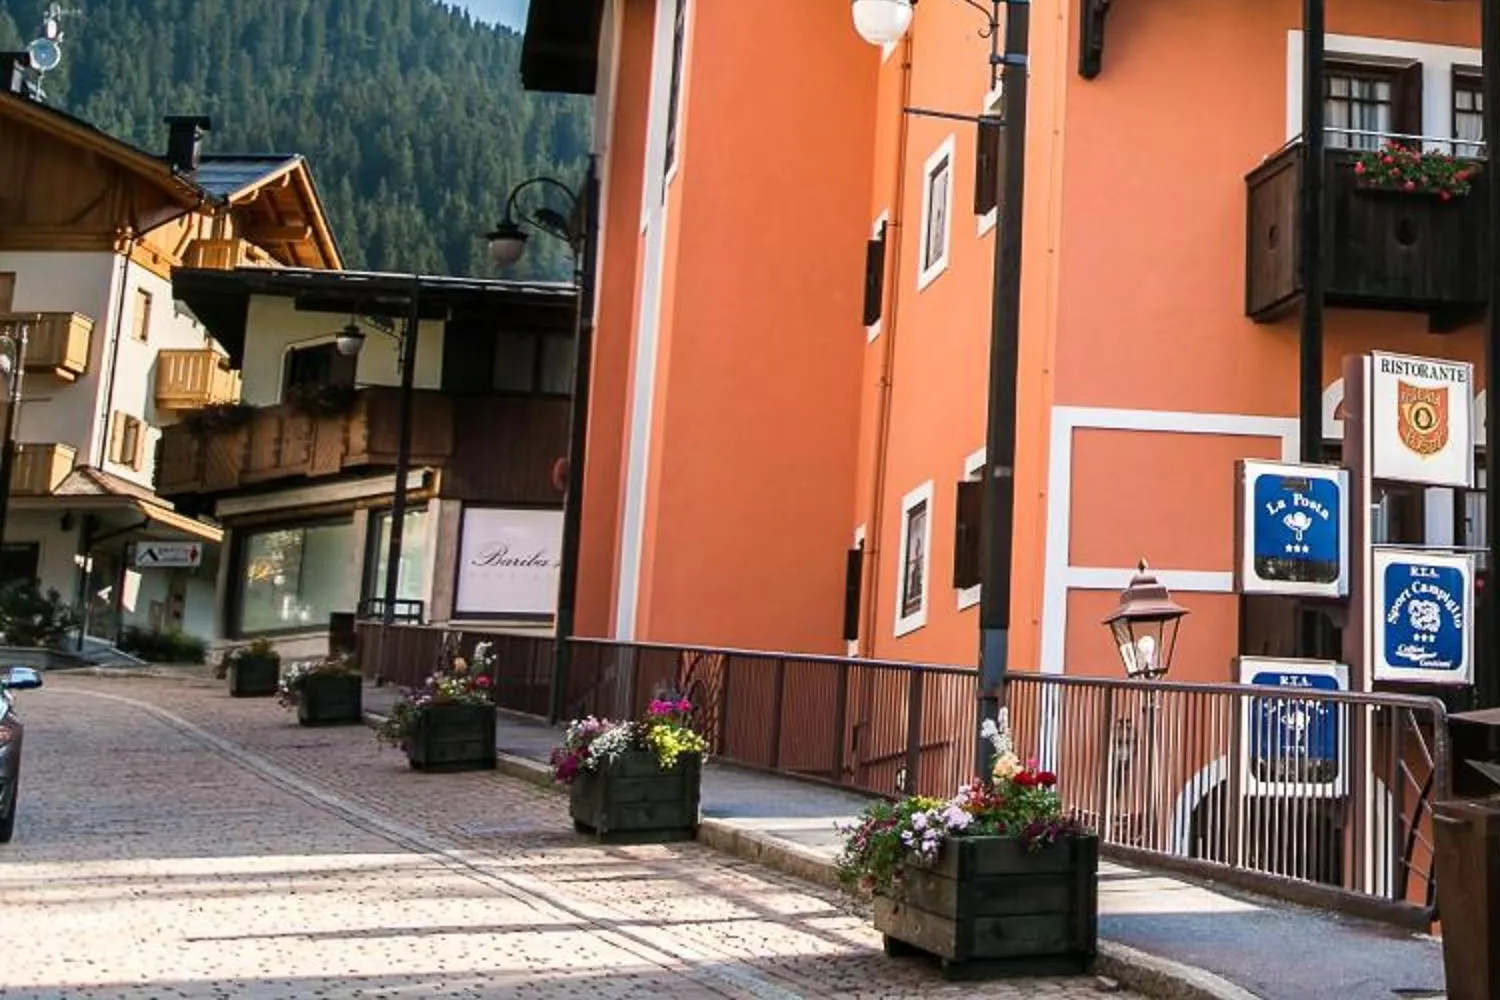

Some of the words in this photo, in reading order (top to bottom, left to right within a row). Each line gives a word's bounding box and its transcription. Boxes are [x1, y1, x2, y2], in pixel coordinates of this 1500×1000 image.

[1381, 358, 1467, 383] RISTORANTE
[1265, 499, 1287, 516] La
[1292, 492, 1330, 521] Posta
[1387, 588, 1412, 625] Sport
[1411, 580, 1463, 629] Campiglio
